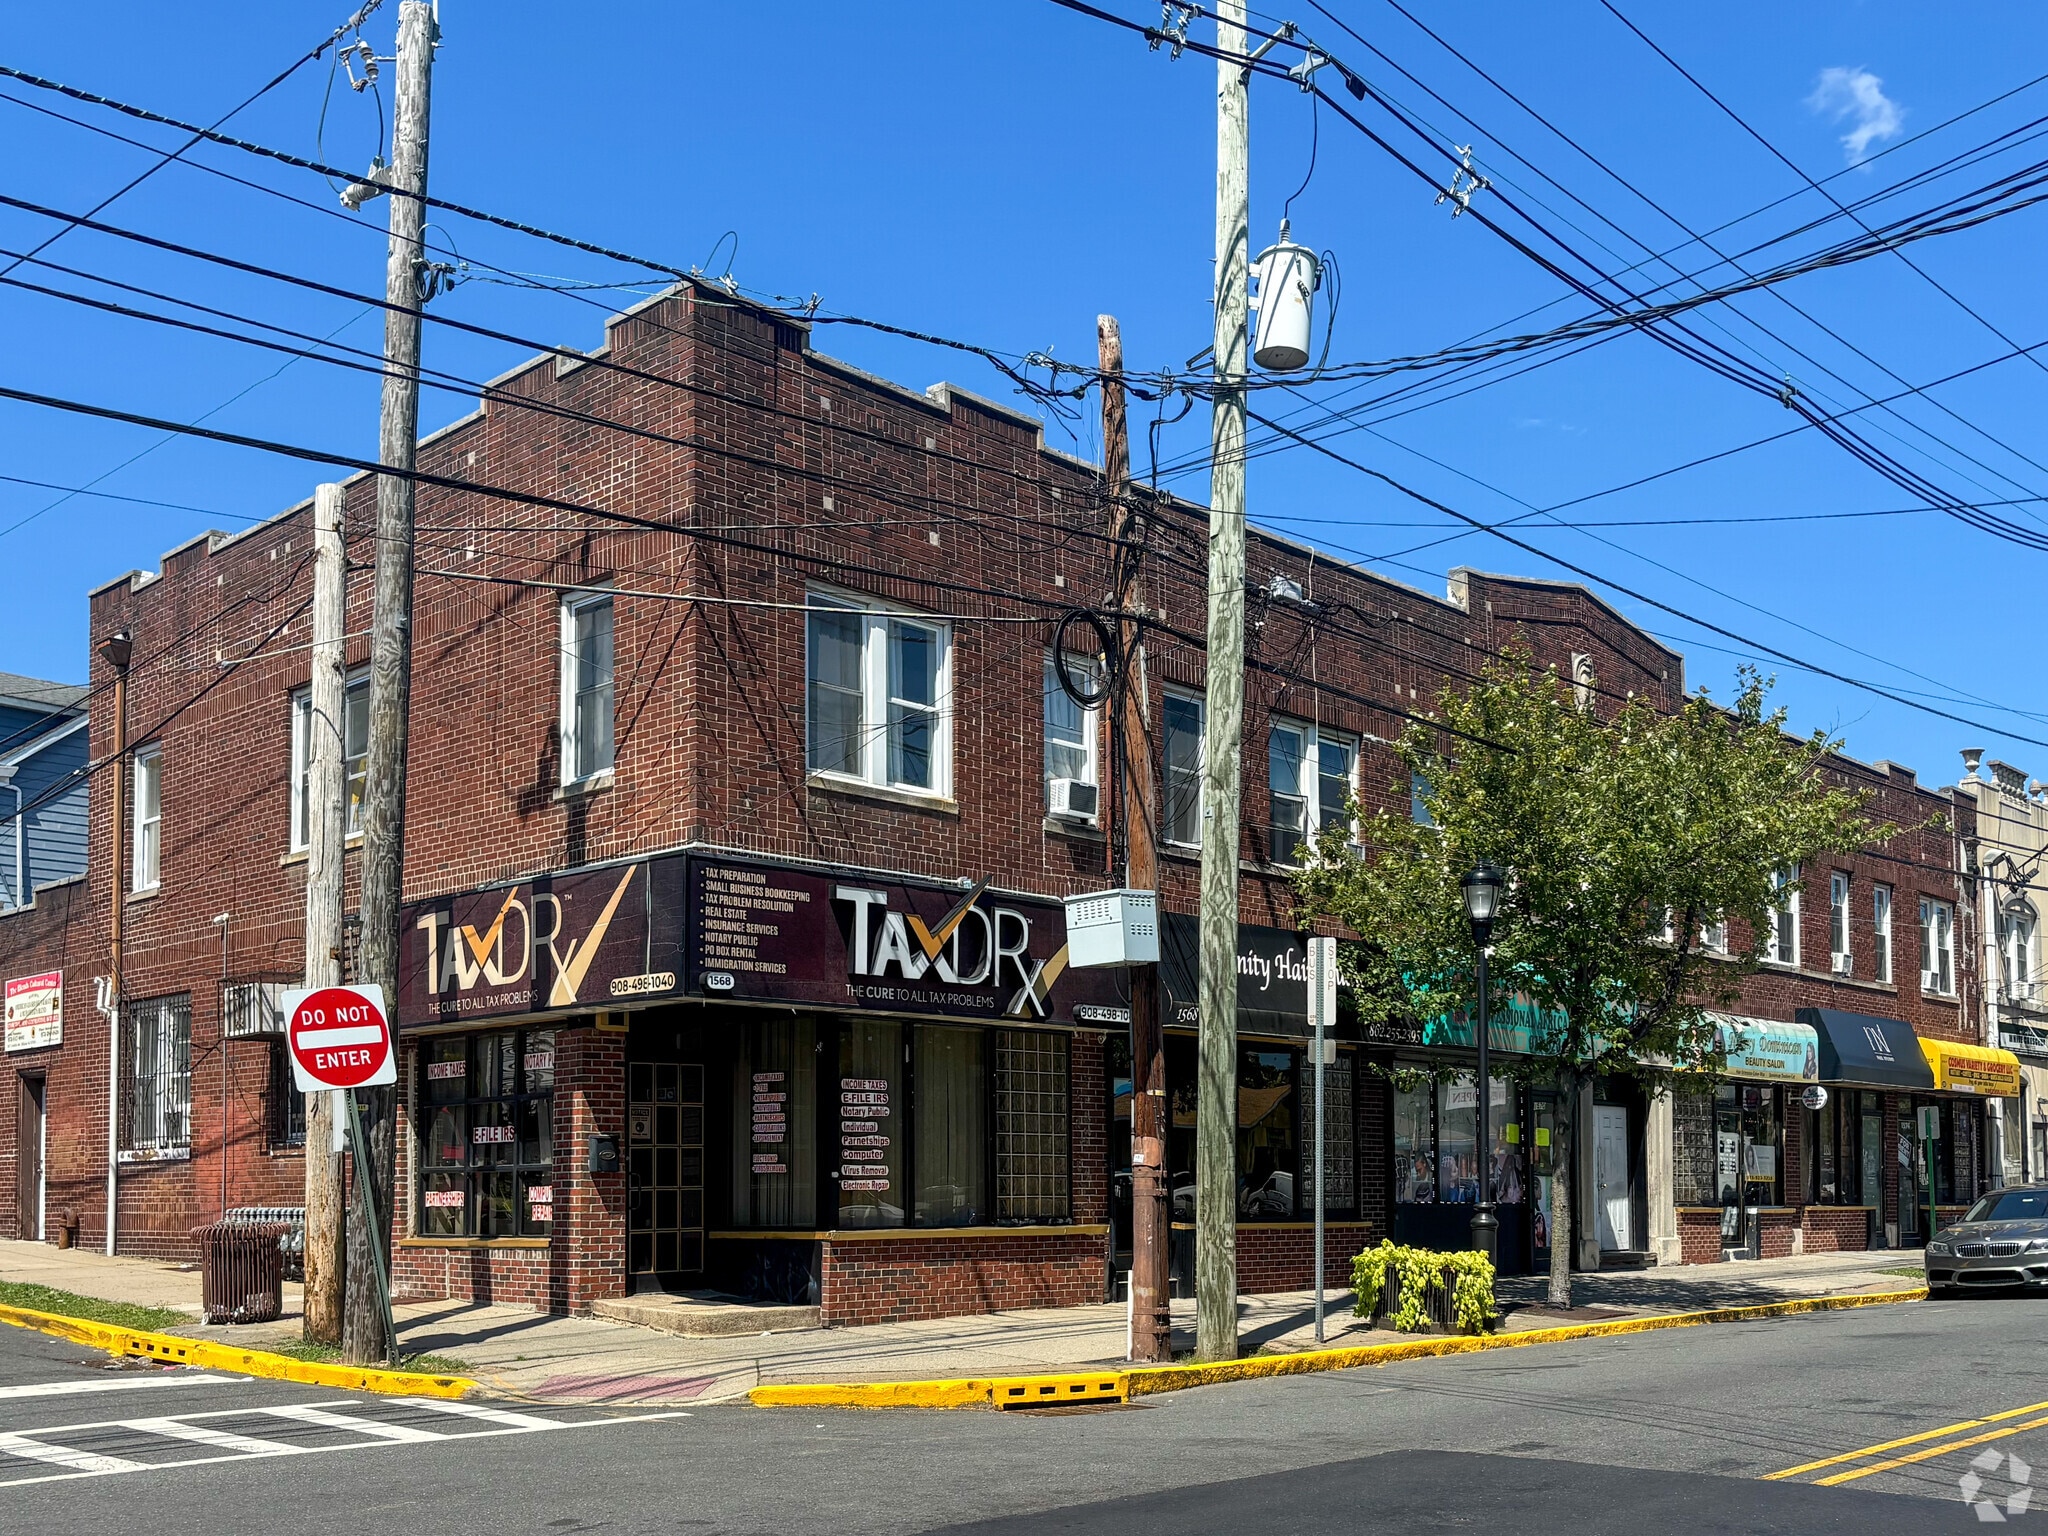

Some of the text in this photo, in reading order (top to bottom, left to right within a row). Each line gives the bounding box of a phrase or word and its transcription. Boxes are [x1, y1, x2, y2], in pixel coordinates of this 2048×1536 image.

[705, 867, 766, 884] TAX PREPARATION
[705, 880, 810, 902] SMALL BUSINESS BOOKKEEPING
[705, 893, 794, 912] TAX PROBLEM RESOLUTION
[705, 906, 747, 920] REAL ESTATE
[705, 919, 778, 936] INSURANCE SERVICES
[705, 932, 758, 946] NOTARY PUBLIC
[705, 945, 757, 959] PO BOX RENTAL
[705, 957, 787, 974] IMMIGRATION SERVICES
[1237, 949, 1270, 990] nity
[1274, 947, 1308, 981] Hai
[611, 974, 674, 993] 908-498-1040
[709, 975, 731, 986] 1568
[428, 989, 539, 1014] THE CURE TO ALL TAX PROBLEMS
[846, 984, 995, 1009] THE CURE TO ALL TAX PROBLEMS
[301, 1006, 369, 1026] DO NOT
[1081, 1005, 1129, 1021] 908-498-10
[1176, 1006, 1199, 1022] 1568
[1369, 1023, 1421, 1043] 862.255.2395
[315, 1050, 371, 1069] ENTER
[524, 1054, 546, 1069] NOTARY
[1745, 1056, 1785, 1069] BEAUTY SALON
[1966, 1058, 1983, 1071] VARIETY
[1987, 1062, 2005, 1074] GROCERY
[428, 1061, 466, 1079] INCOME TAXES
[843, 1079, 886, 1090] INCOME TAXES
[843, 1093, 888, 1103] E-FILE IRS
[843, 1106, 888, 1117] Notary Public
[474, 1125, 514, 1143] E-FILE IRS
[843, 1122, 876, 1131] Individual
[843, 1149, 883, 1161] Computer
[843, 1166, 887, 1175] Virus Removal
[843, 1180, 889, 1191] Electronic Repair
[426, 1192, 464, 1207] PARTNERSHIPS
